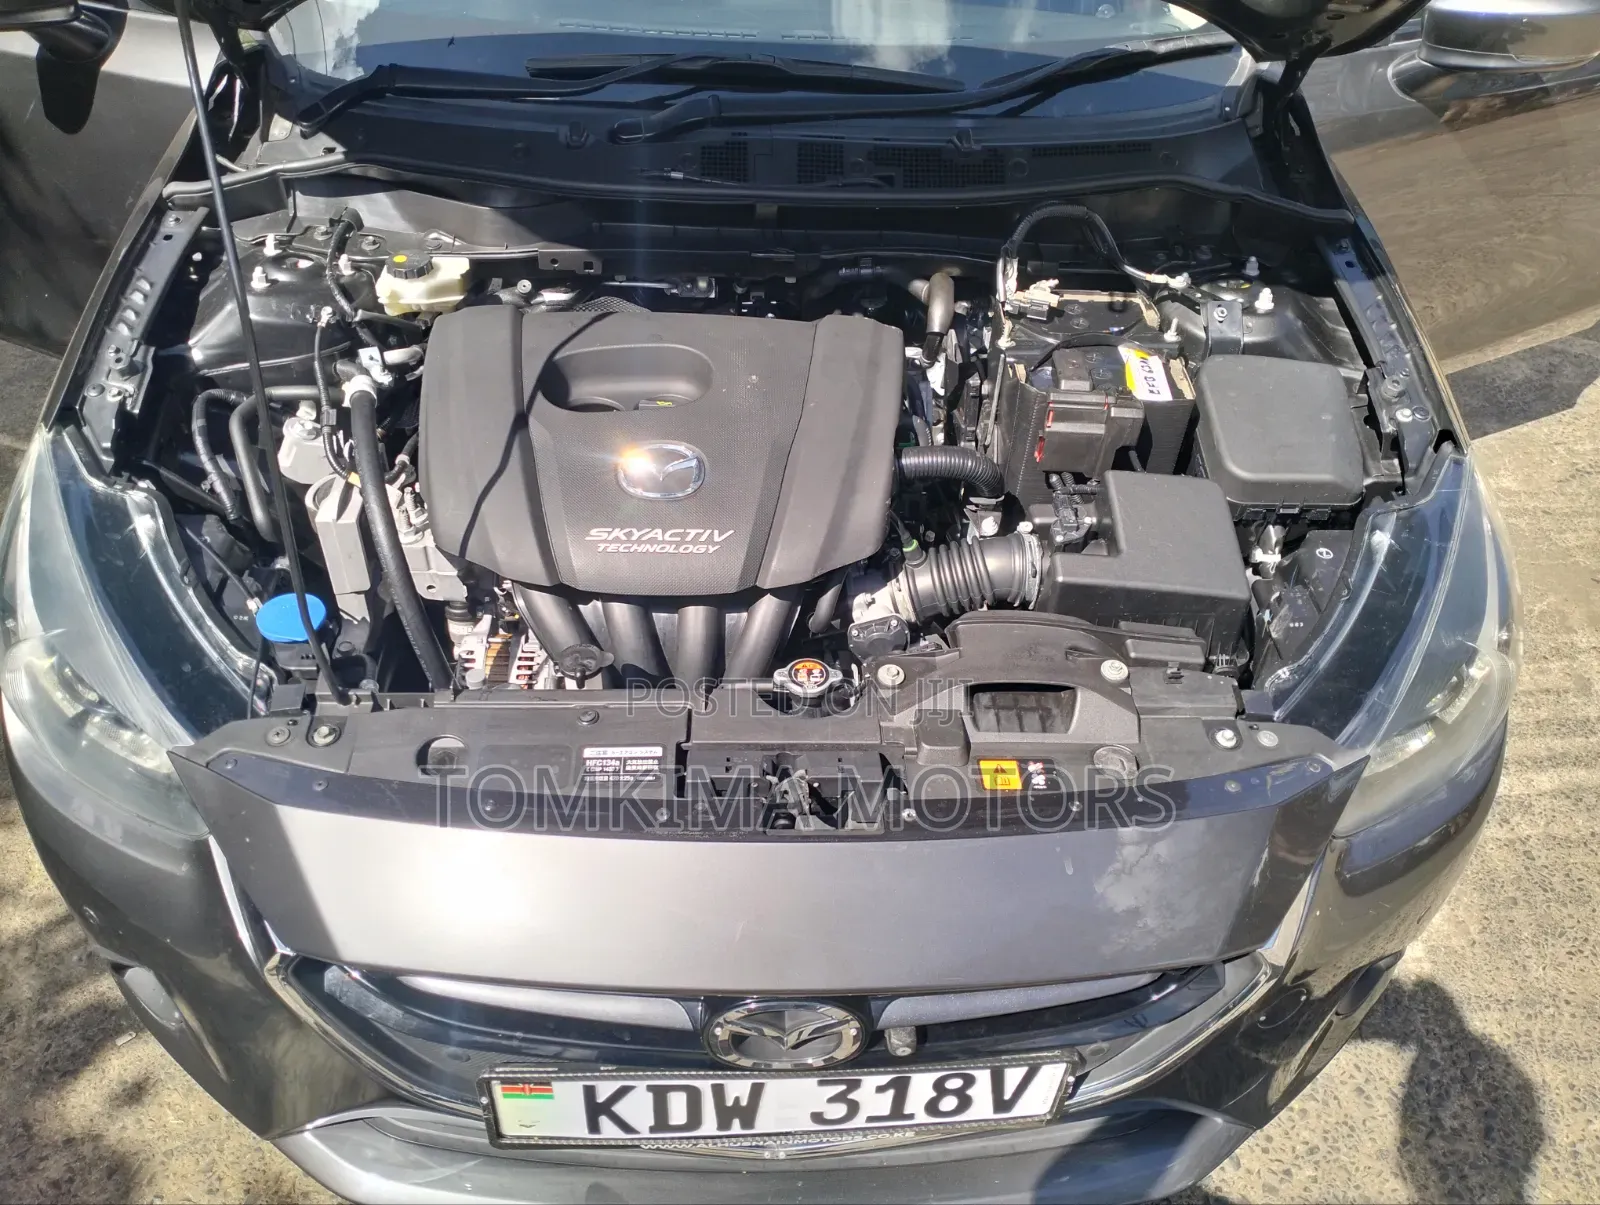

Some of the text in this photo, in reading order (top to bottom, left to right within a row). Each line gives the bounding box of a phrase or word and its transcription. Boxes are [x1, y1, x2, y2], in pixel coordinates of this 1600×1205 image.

[585, 528, 735, 542] SKYACTIV
[597, 543, 721, 554] TECHNOLOGY
[582, 1082, 766, 1135] KDW
[809, 1064, 1043, 1126] 318V
